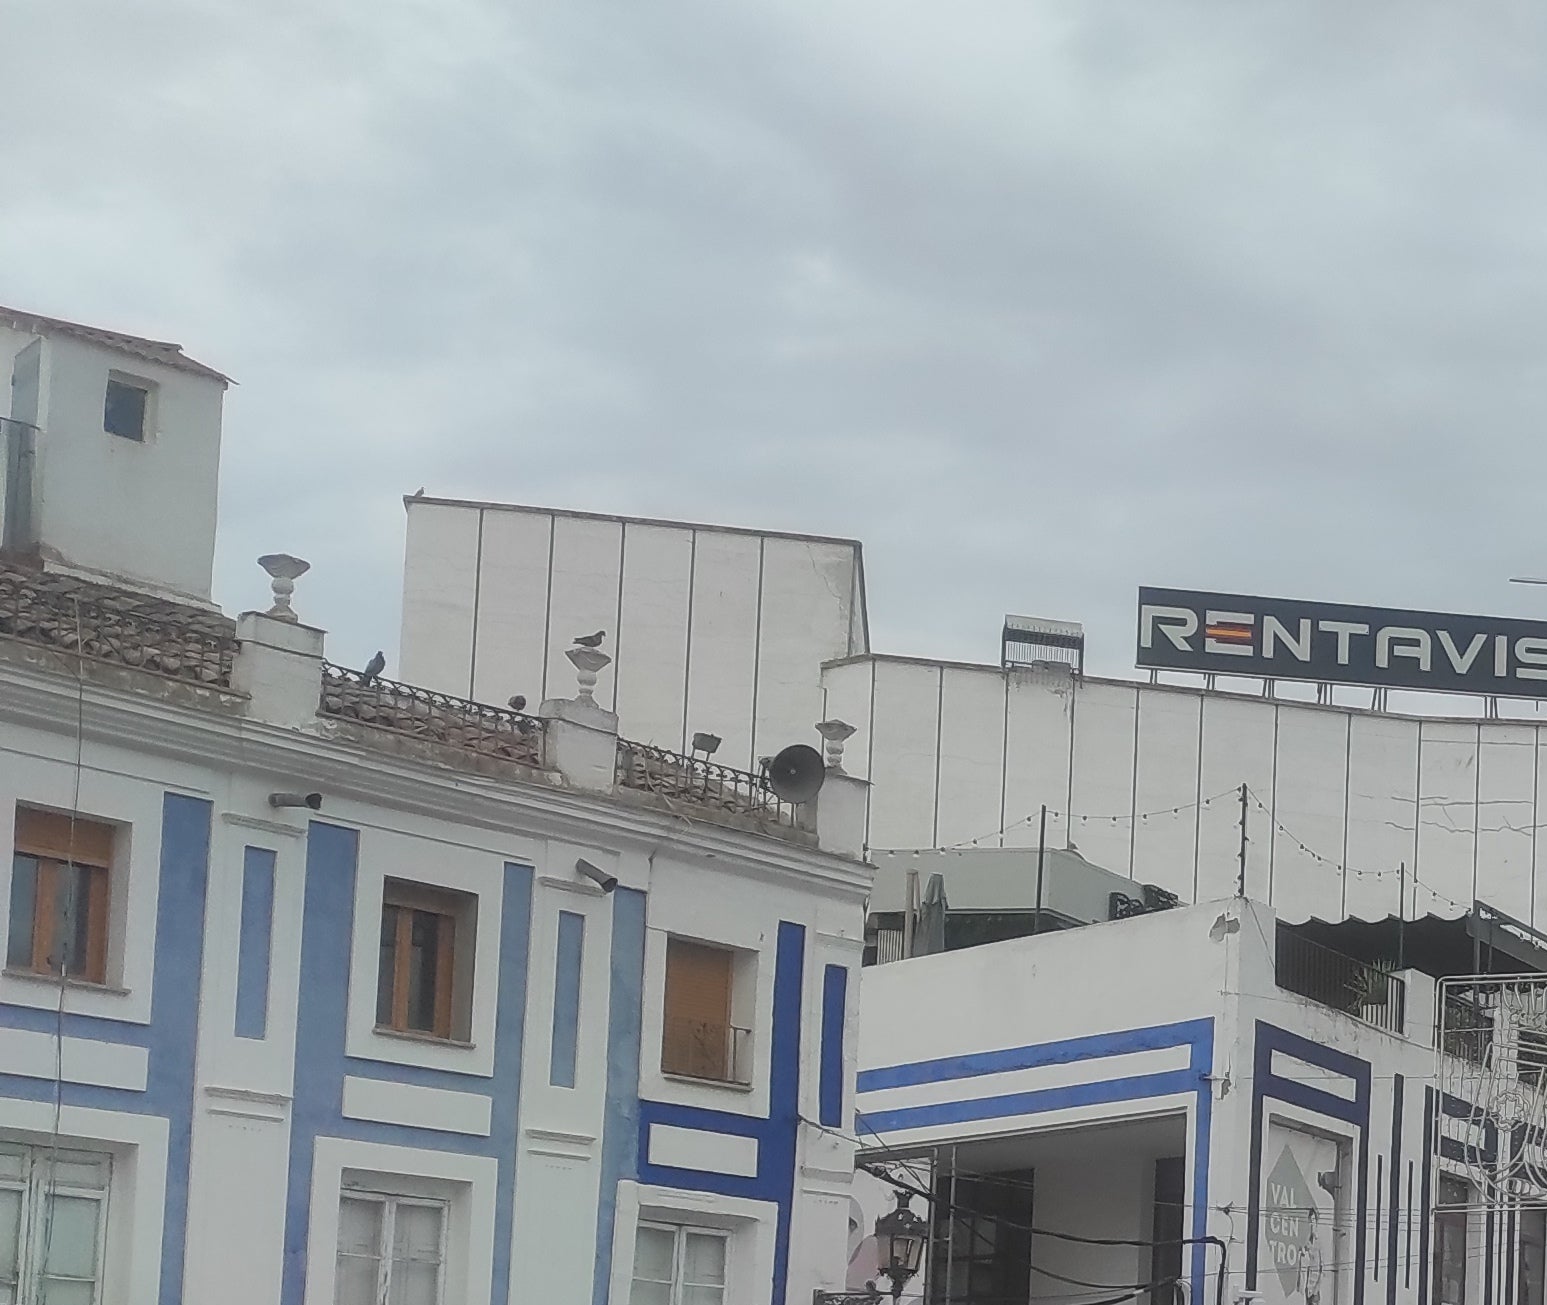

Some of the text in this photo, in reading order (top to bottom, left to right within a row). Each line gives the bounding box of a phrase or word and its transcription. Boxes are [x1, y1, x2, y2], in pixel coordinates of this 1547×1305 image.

[1270, 1182, 1297, 1208] VAL
[1270, 1211, 1299, 1237] CEN
[1269, 1240, 1297, 1266] TRO
